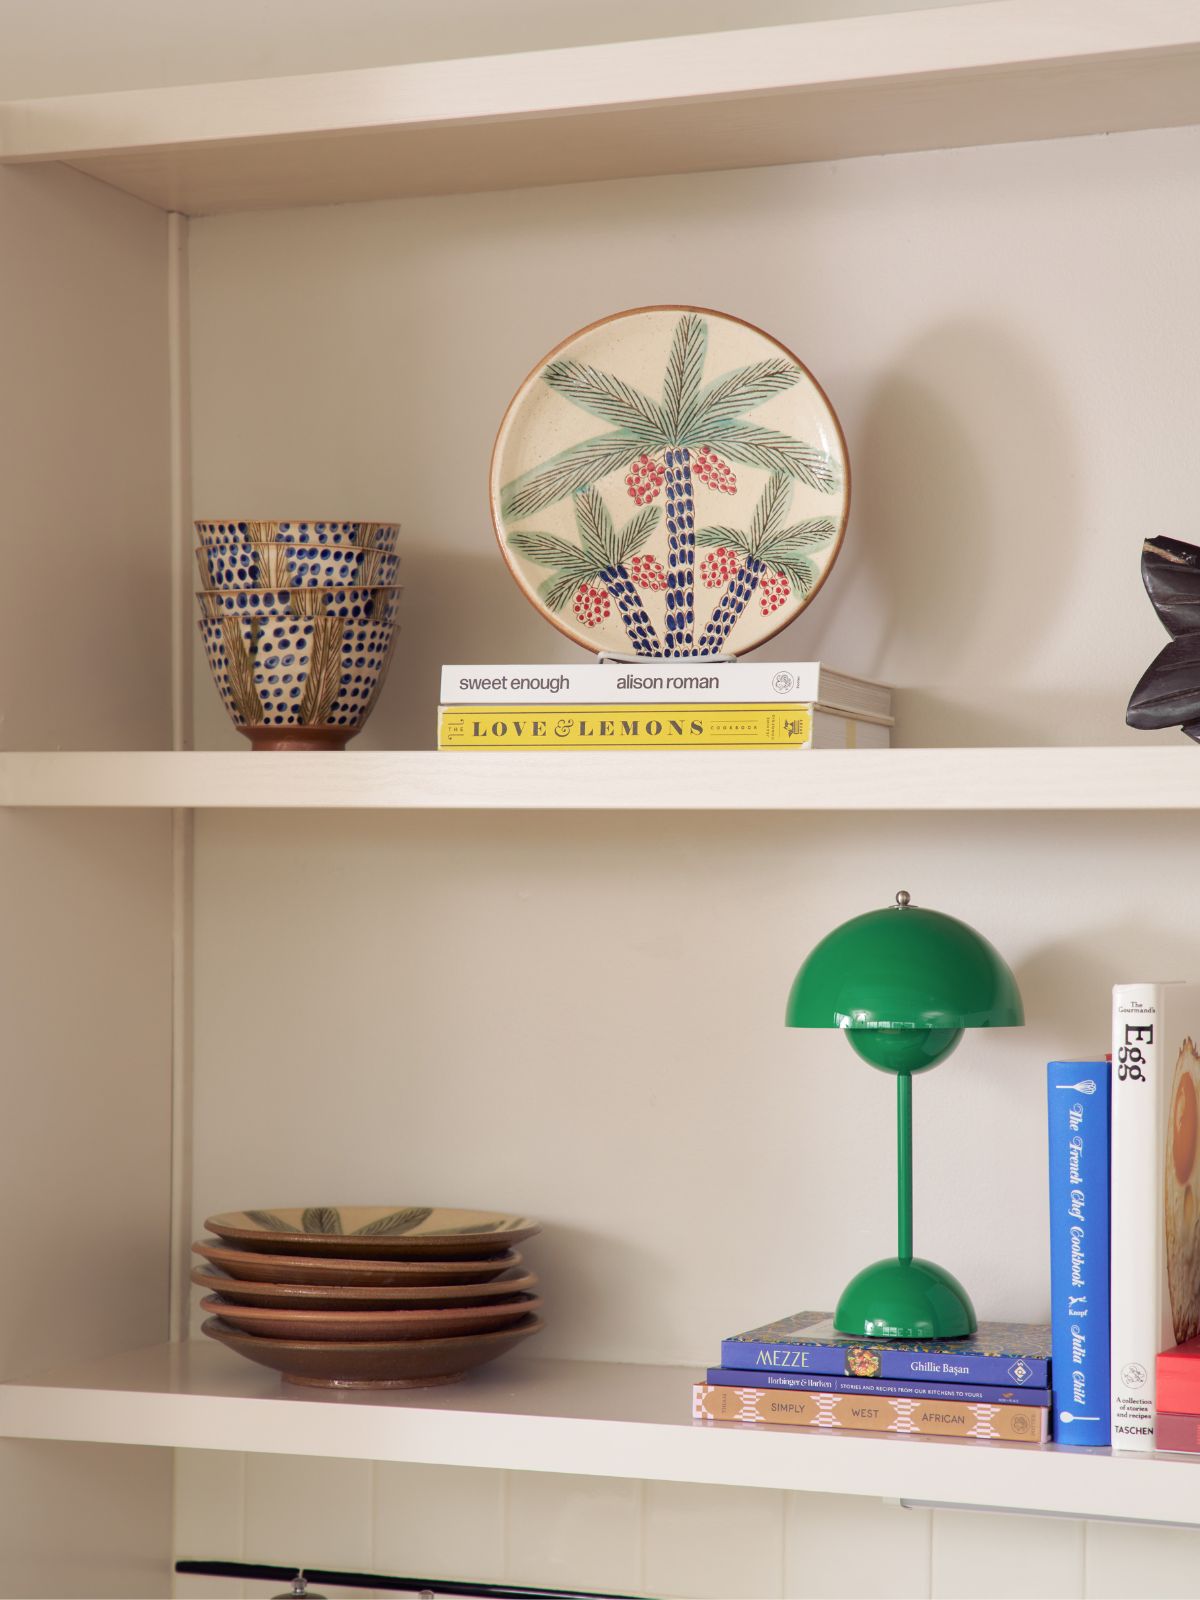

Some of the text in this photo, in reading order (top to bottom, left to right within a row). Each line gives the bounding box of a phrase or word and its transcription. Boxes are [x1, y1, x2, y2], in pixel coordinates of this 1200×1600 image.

[459, 674, 719, 694] sweet enough alison roman
[472, 721, 547, 736] LOVE
[554, 719, 574, 737] &
[577, 719, 704, 736] LEMONS
[1118, 1024, 1154, 1082] Egg
[1067, 1103, 1085, 1287] The French Chef Cookbook
[756, 1350, 810, 1368] MEZZE
[1071, 1324, 1086, 1405] Julia Child
[910, 1361, 969, 1376] Ghillie Başan
[928, 1389, 955, 1397] KITCHENS
[1121, 1397, 1152, 1405] collection
[771, 1402, 965, 1424] SIMPLY WEST AFRICAN
[1115, 1426, 1154, 1435] TASCHEN
